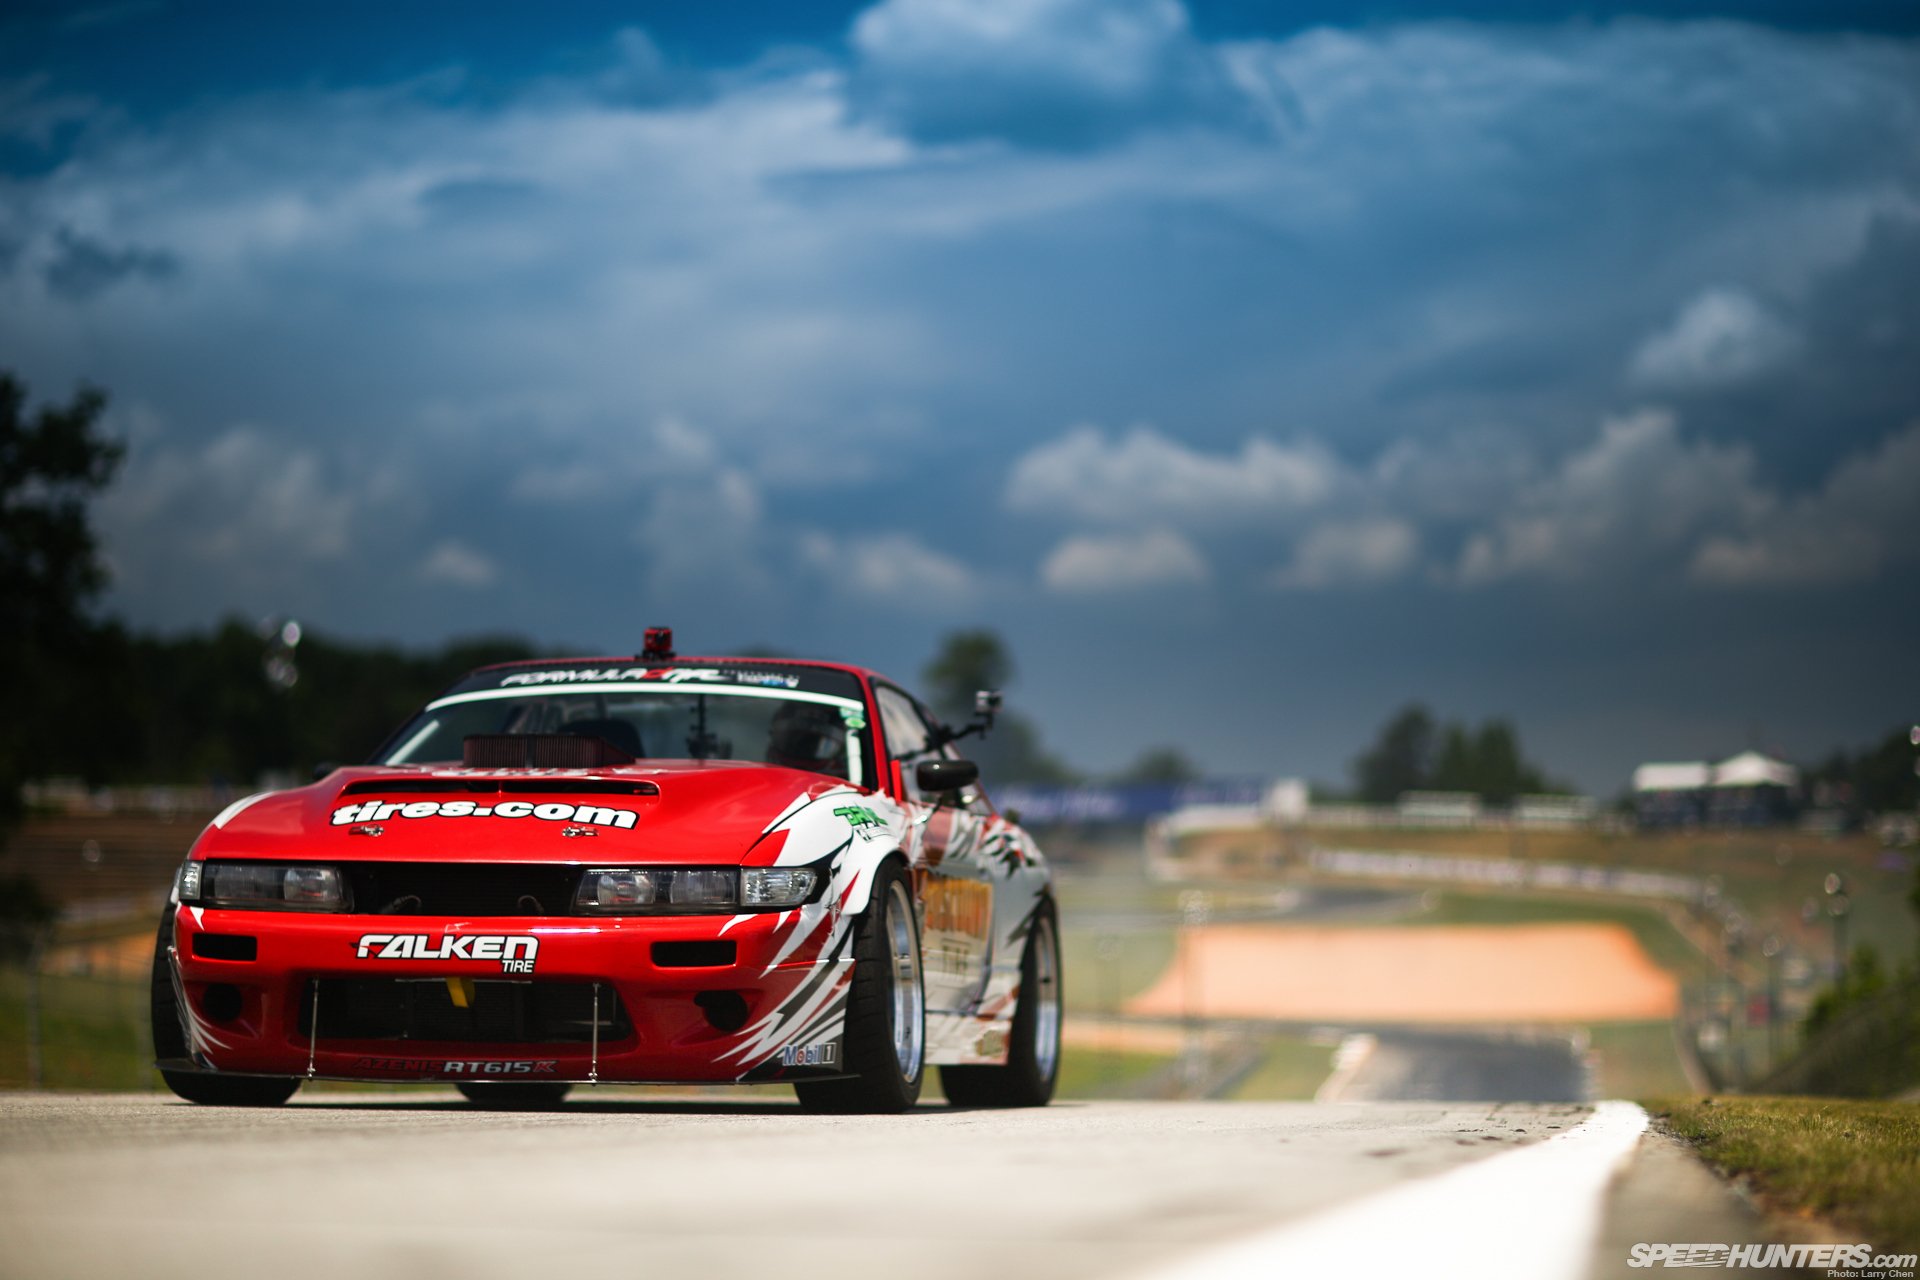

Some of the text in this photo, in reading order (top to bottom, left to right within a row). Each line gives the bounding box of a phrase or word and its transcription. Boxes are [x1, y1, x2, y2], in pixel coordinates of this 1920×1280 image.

[330, 800, 640, 829] tires.com
[356, 934, 539, 960] FALKEN
[502, 960, 535, 973] TIRE
[782, 1043, 822, 1066] Mobil
